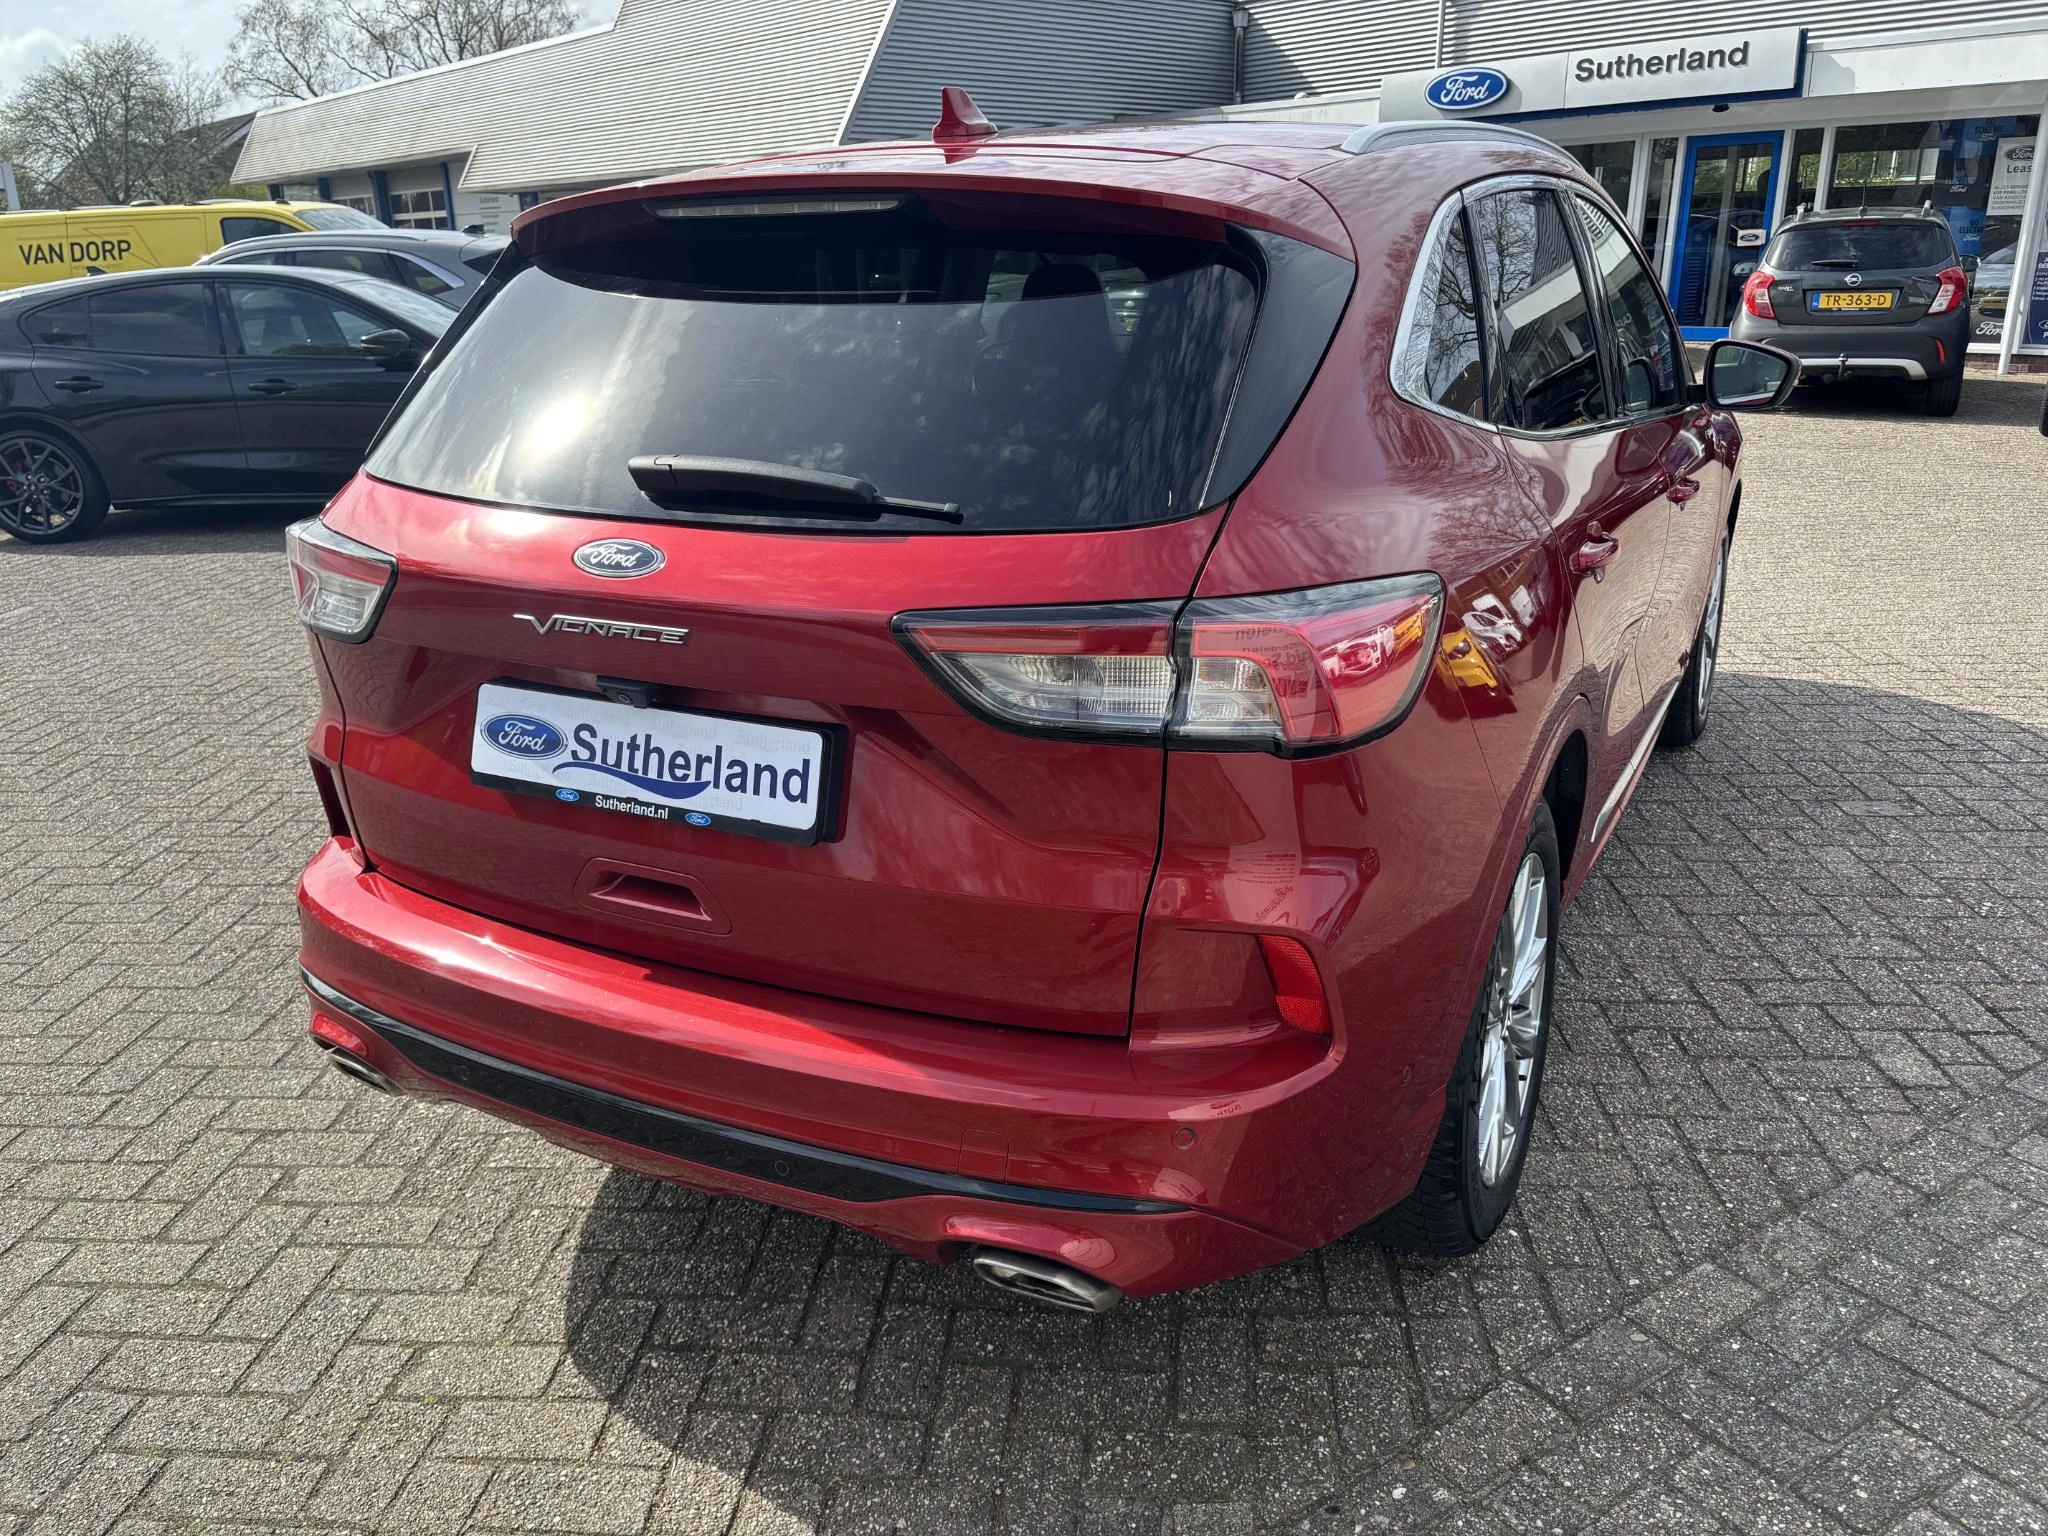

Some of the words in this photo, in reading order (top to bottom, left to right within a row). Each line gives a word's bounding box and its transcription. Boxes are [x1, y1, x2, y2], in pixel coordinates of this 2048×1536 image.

[1575, 41, 1750, 82] Sutherland
[1441, 75, 1490, 103] Ford
[2007, 164, 2033, 174] Leas
[1949, 185, 1968, 193] Ford
[1963, 233, 1982, 241] Ford
[18, 242, 65, 265] VAN
[70, 239, 132, 263] DORP
[1824, 294, 1887, 307] TR-363-D
[1976, 321, 2004, 336] For
[590, 543, 643, 567] Ford
[498, 720, 548, 752] Ford
[571, 723, 811, 804] Sutherland
[595, 795, 669, 820] Sutherland.nl
